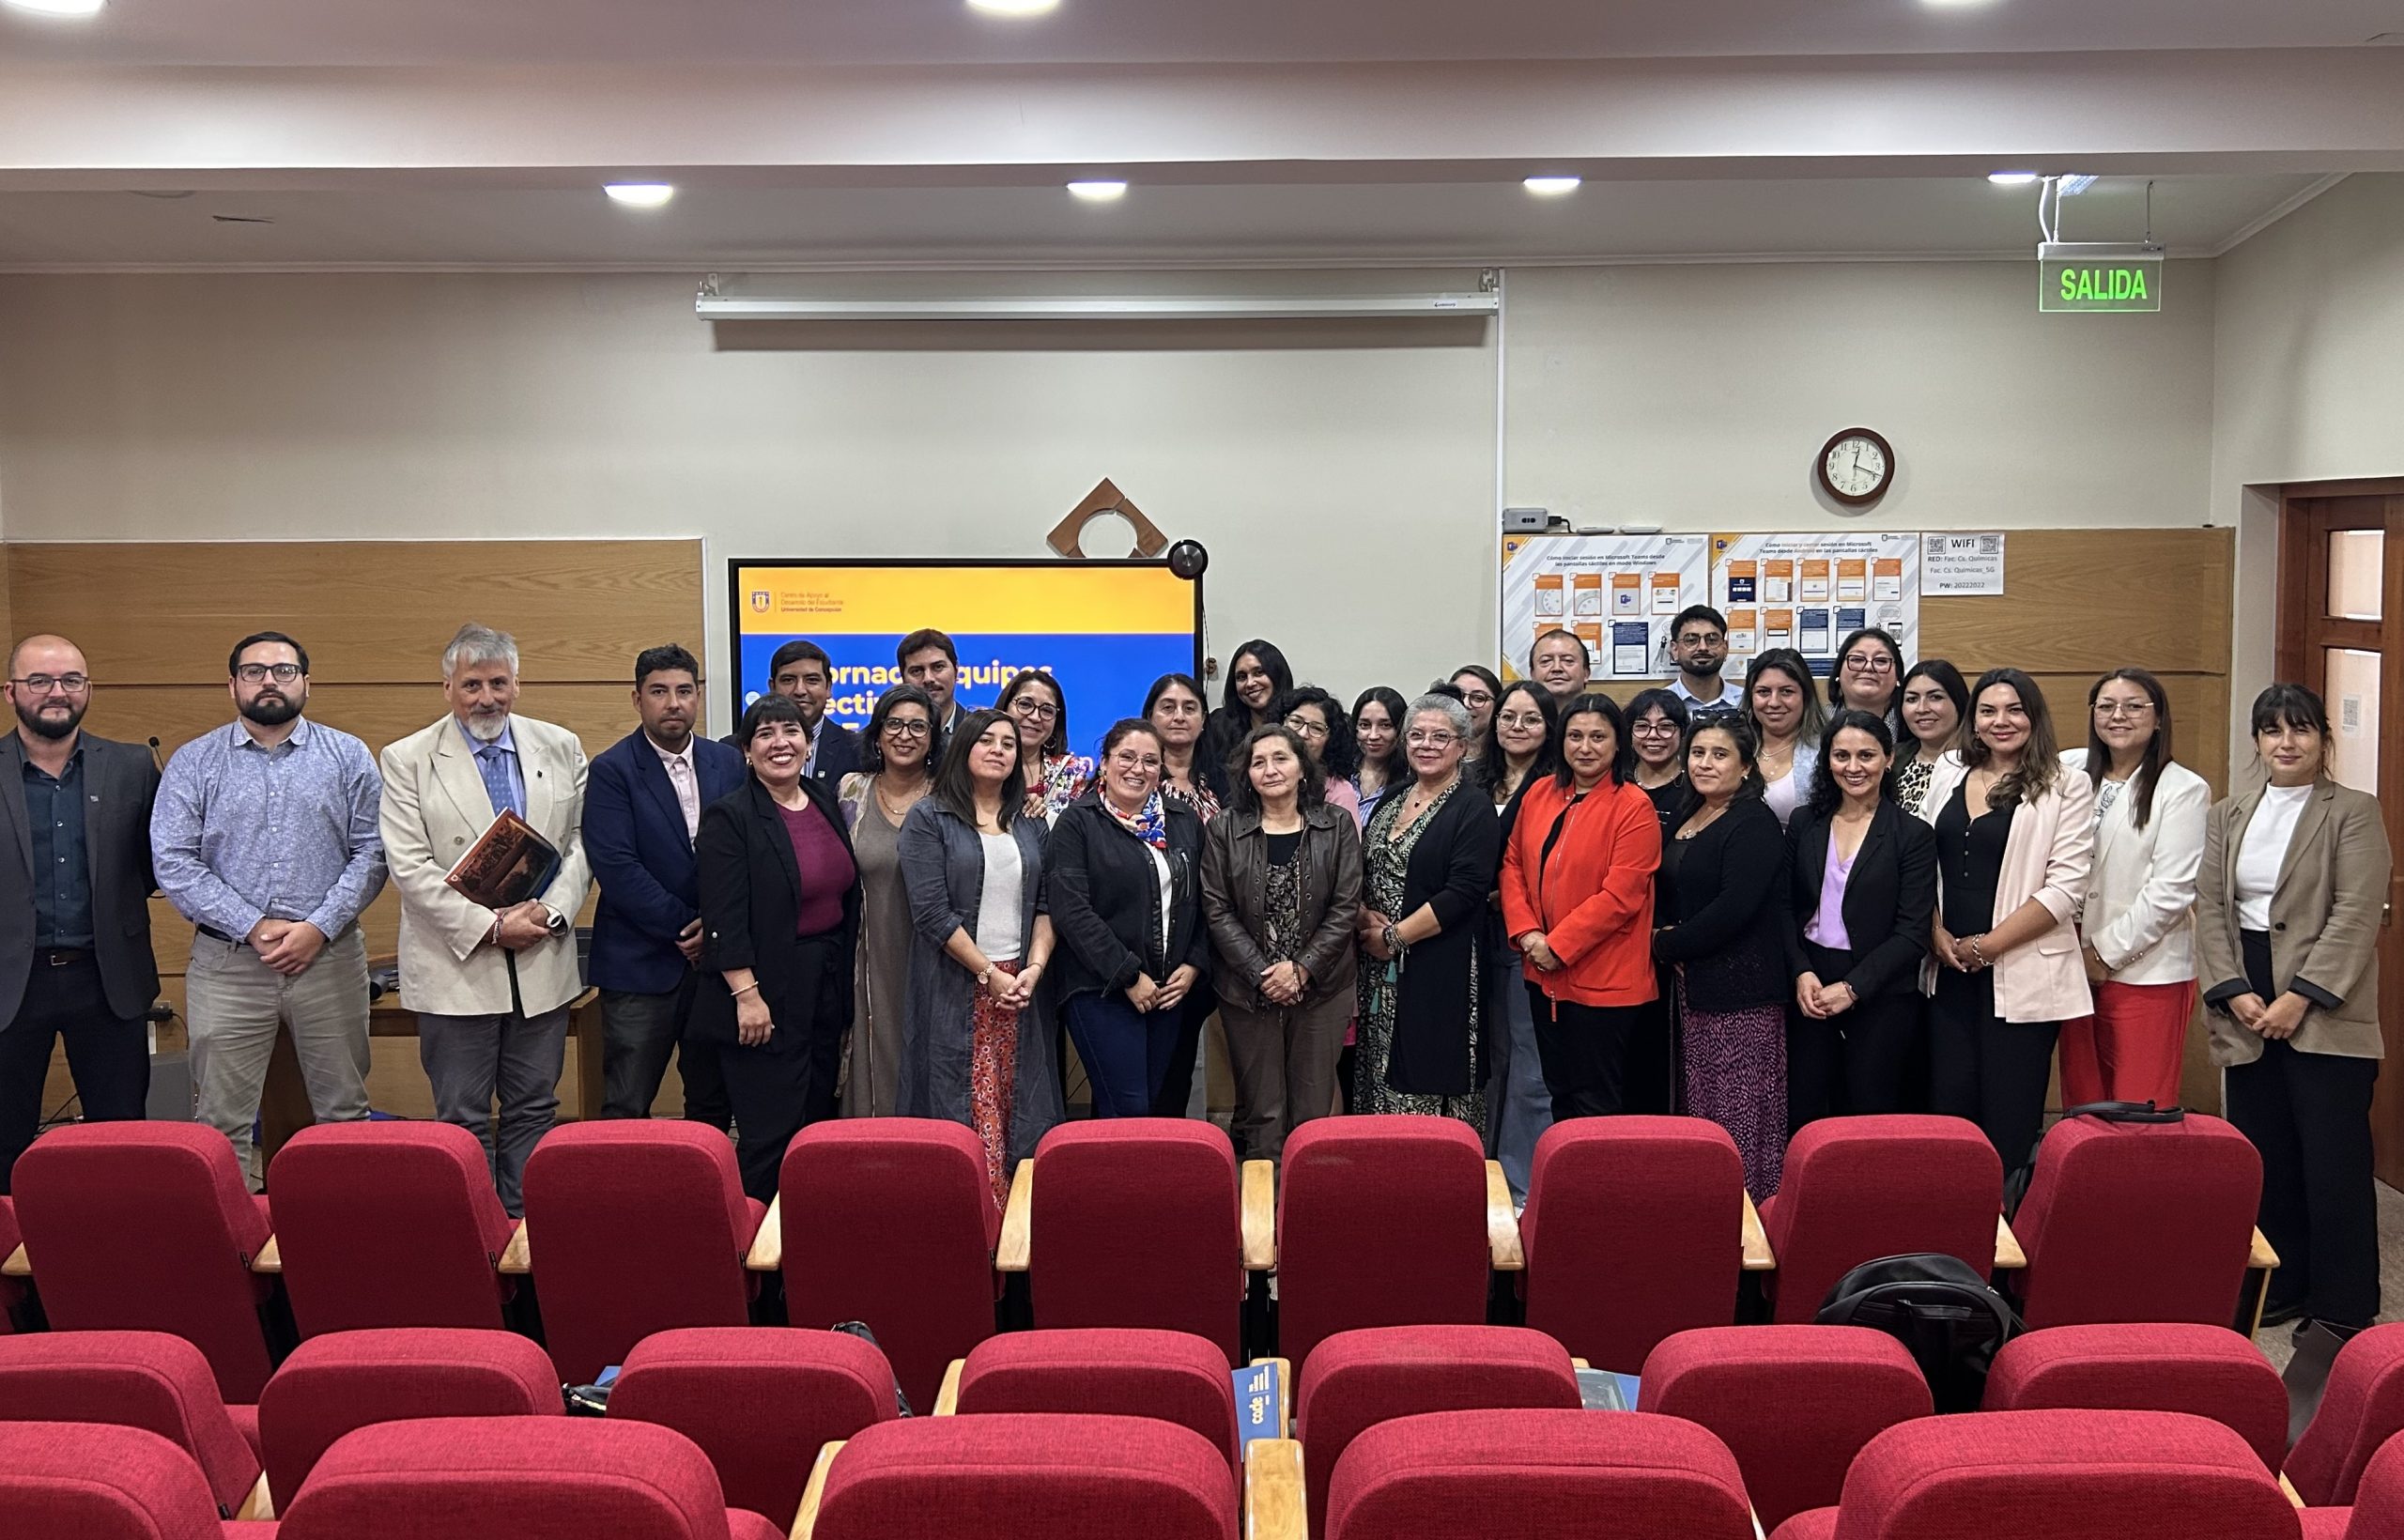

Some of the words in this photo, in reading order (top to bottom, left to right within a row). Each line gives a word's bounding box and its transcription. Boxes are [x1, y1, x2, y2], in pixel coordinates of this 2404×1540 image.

[2060, 269, 2148, 300] SALIDA
[1852, 440, 1860, 448] 12
[1950, 538, 1975, 548] WIFI
[957, 659, 1053, 690] quip
